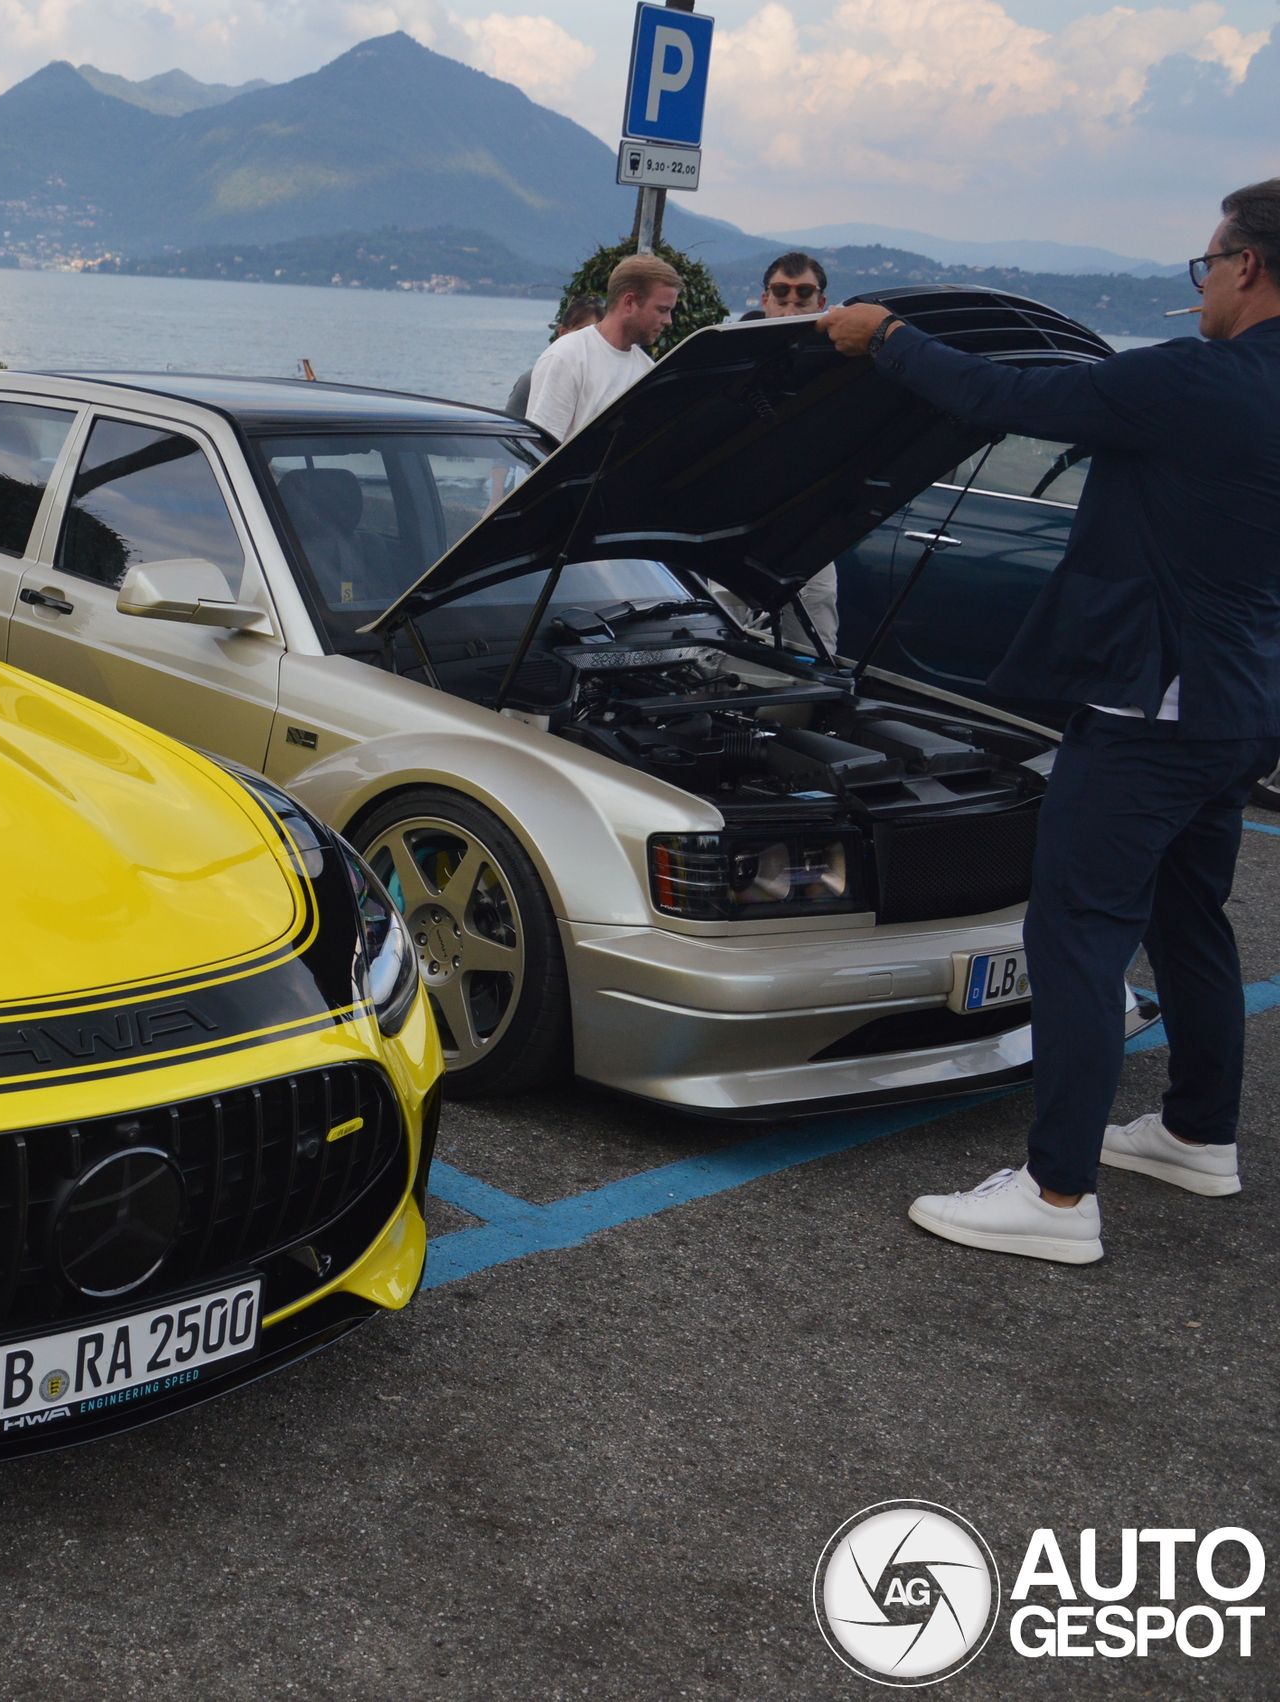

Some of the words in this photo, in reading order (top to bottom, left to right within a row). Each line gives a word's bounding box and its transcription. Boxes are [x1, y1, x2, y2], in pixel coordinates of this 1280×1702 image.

[645, 25, 694, 122] P
[973, 988, 980, 999] D
[986, 957, 1017, 999] LB
[74, 1325, 133, 1393] RA
[146, 1289, 254, 1373] 2500
[3, 1406, 71, 1432] HWA
[80, 1381, 160, 1413] ENGINEERING
[164, 1369, 200, 1389] SPEED
